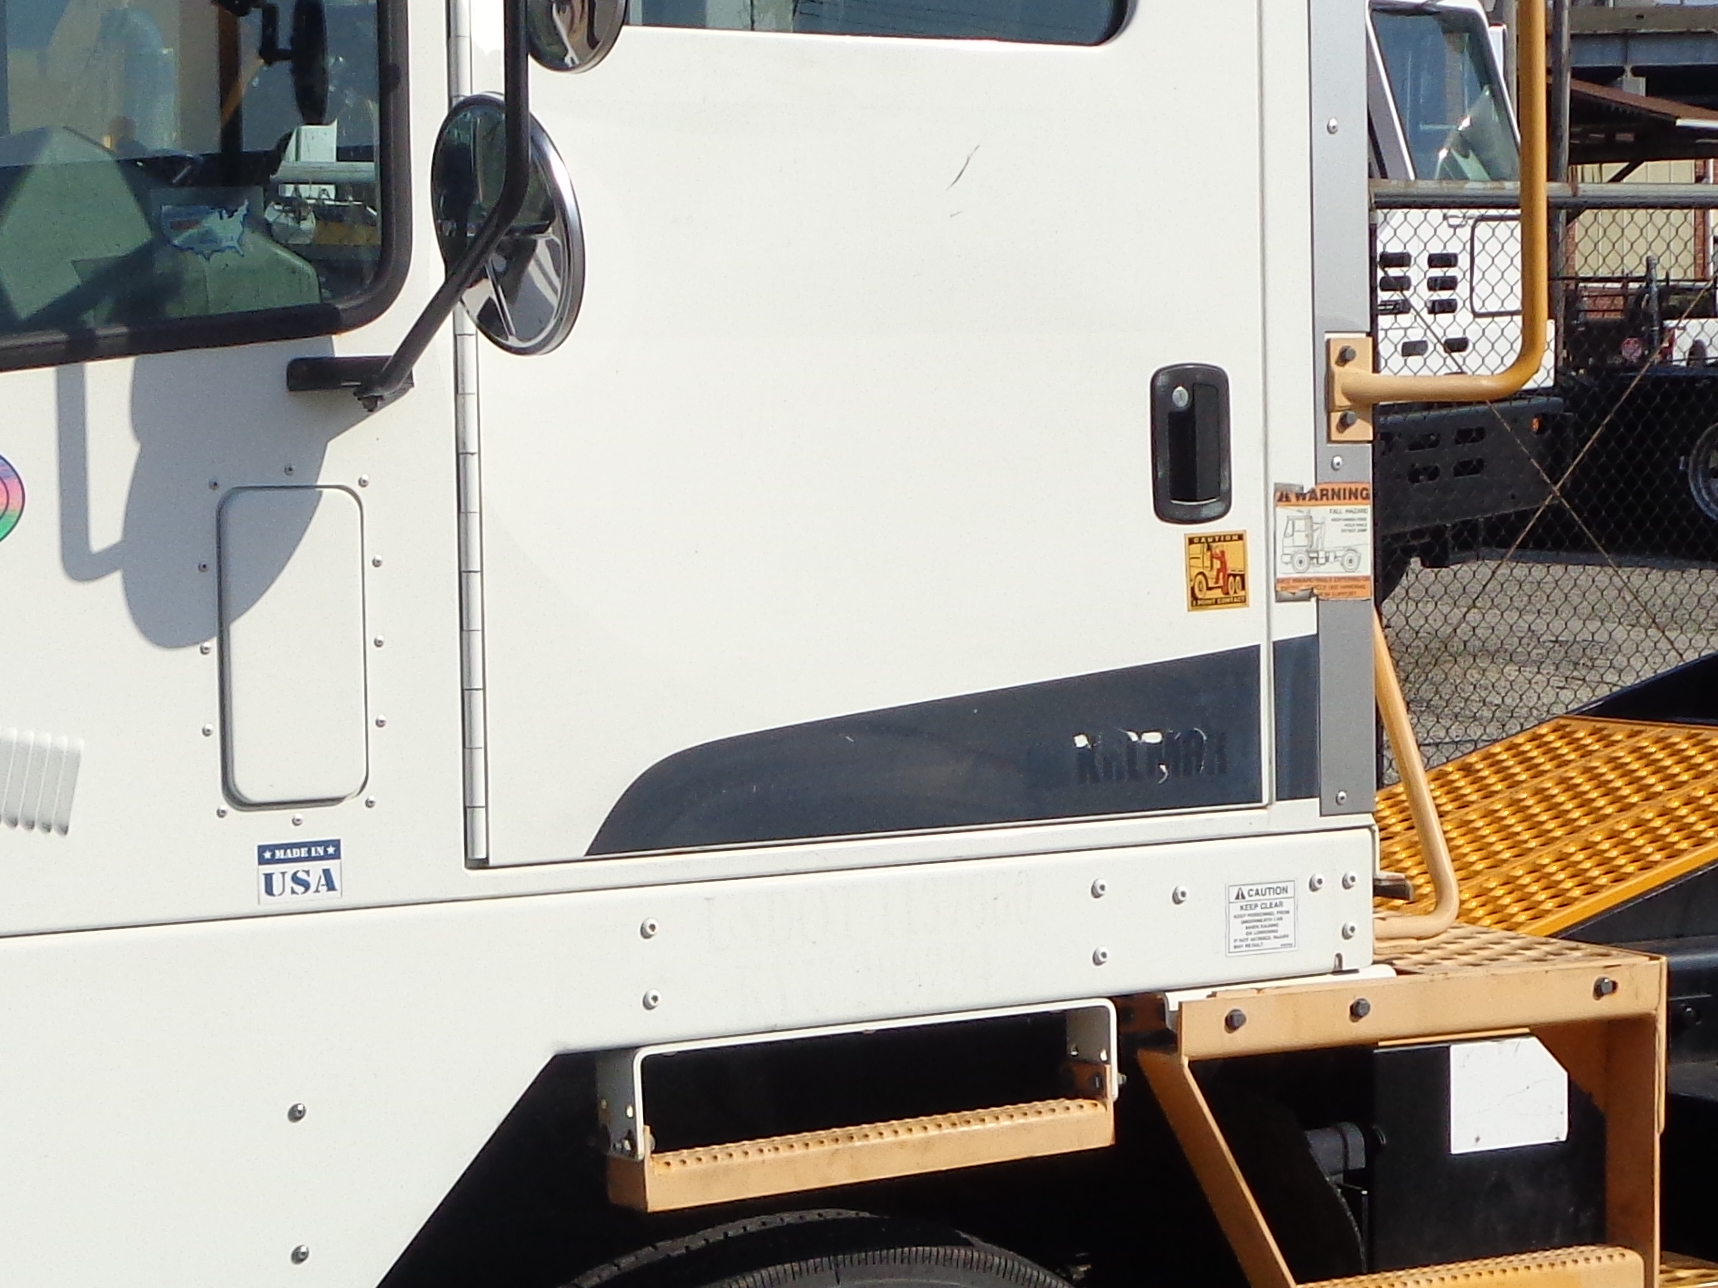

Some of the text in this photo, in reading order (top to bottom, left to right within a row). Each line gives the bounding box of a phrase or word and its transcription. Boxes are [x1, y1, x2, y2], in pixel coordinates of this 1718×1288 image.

[1193, 534, 1239, 544] CAUTION
[274, 845, 325, 860] MADE IN
[262, 867, 338, 898] USA
[1247, 885, 1289, 898] CAUTION
[1239, 901, 1284, 911] KEEP CLEAR
